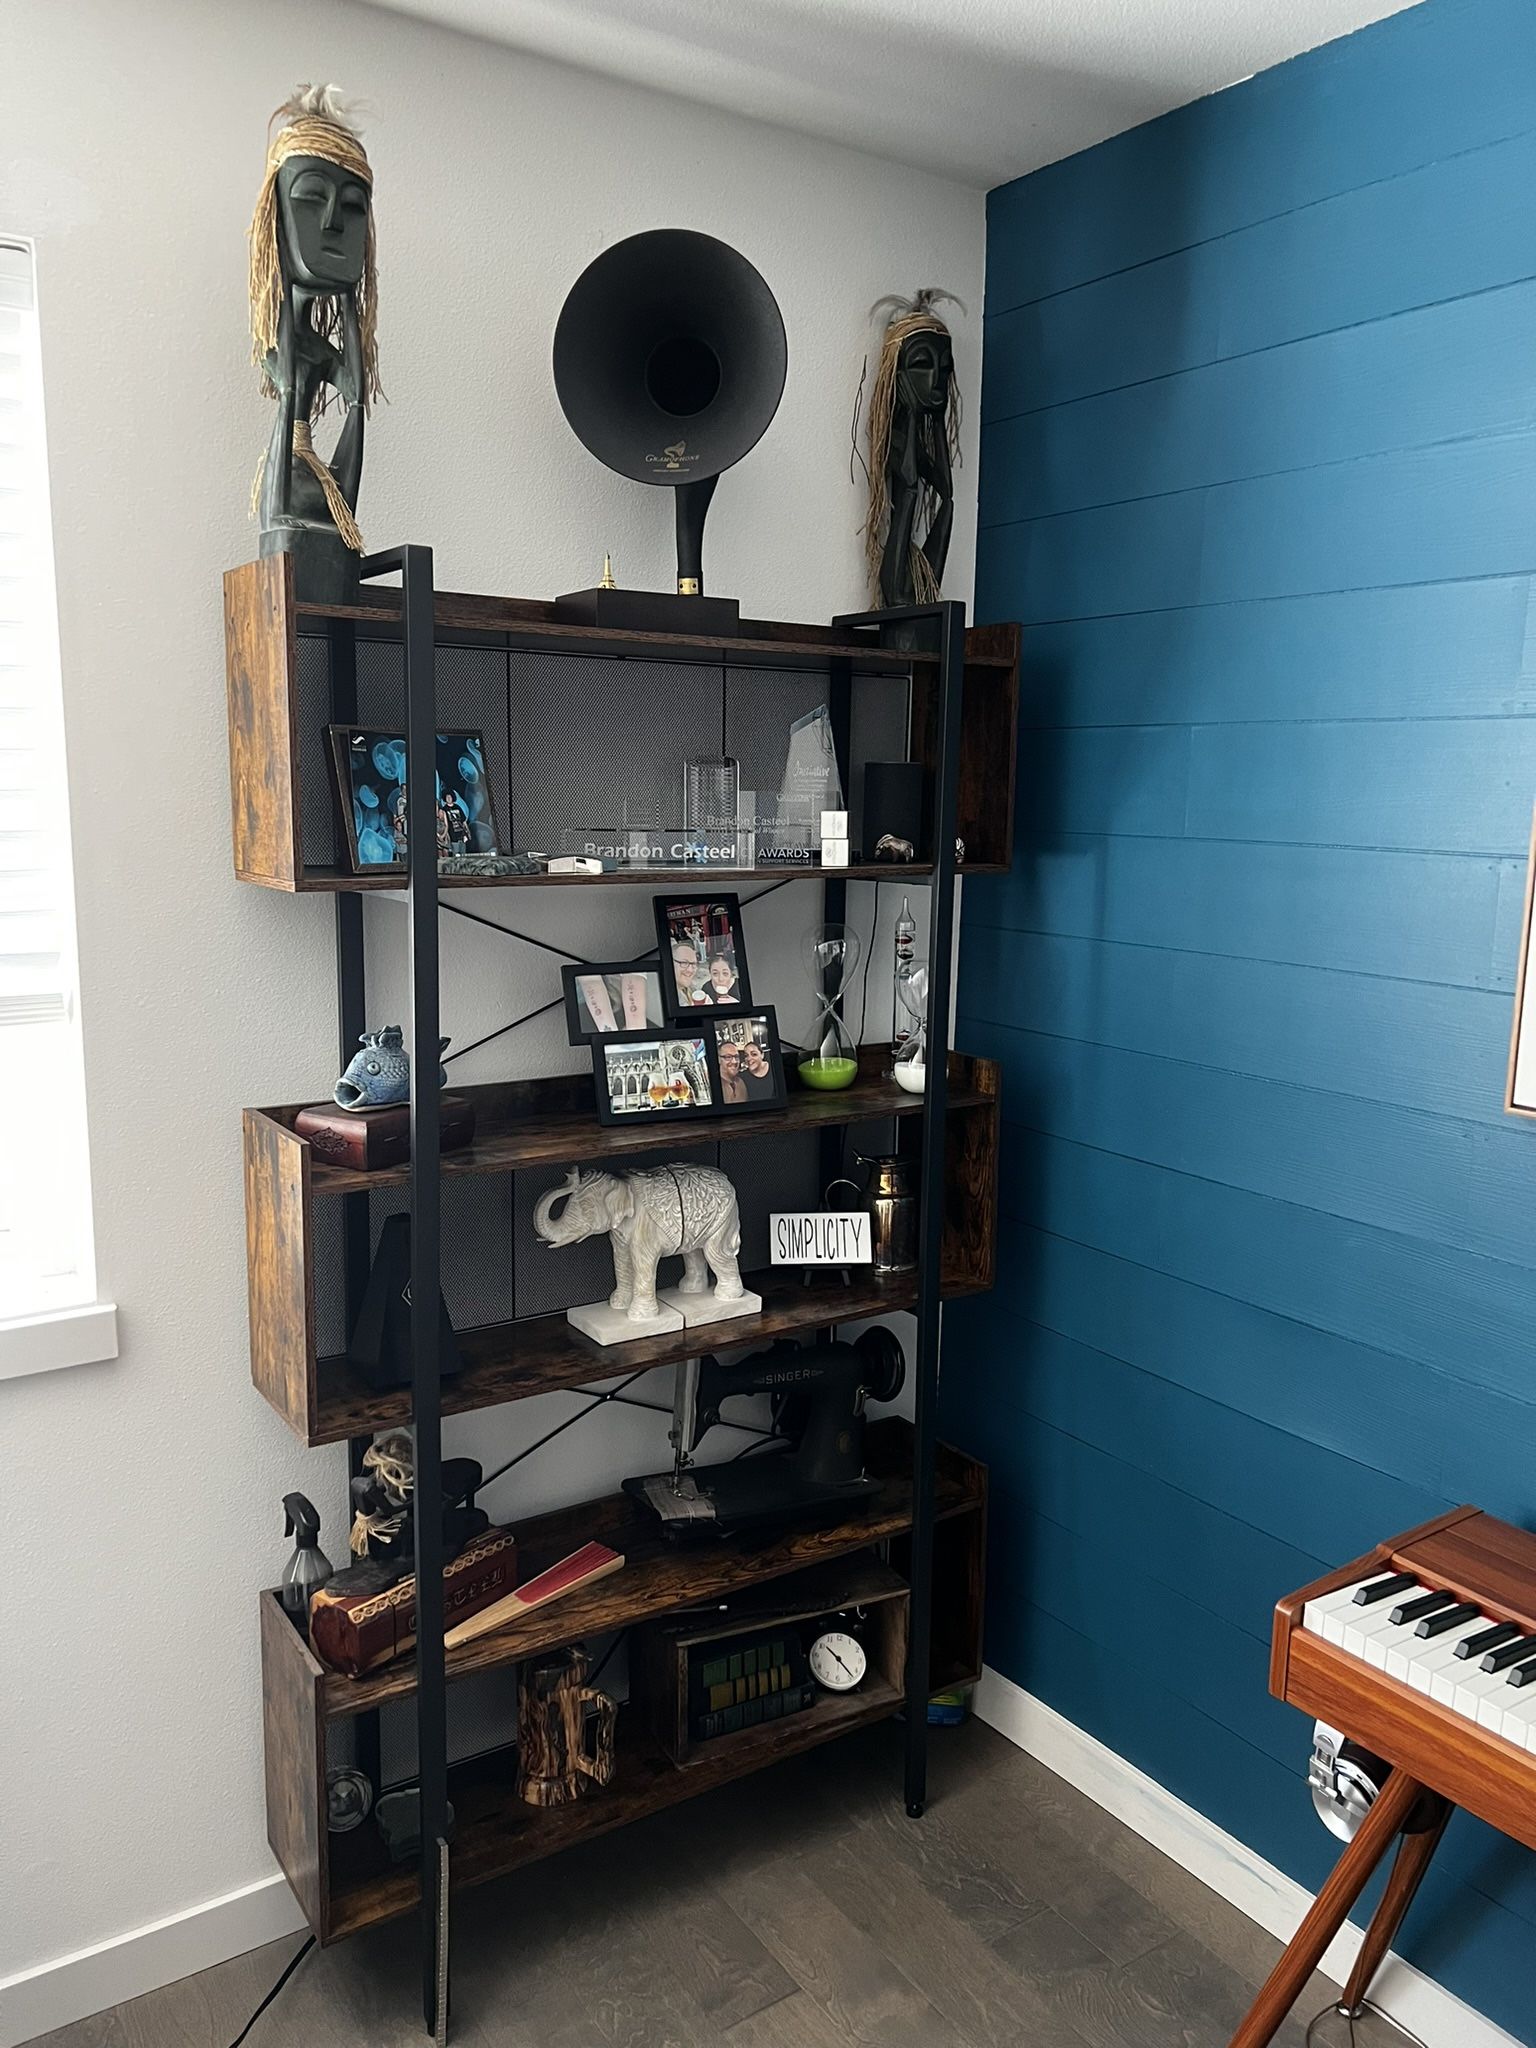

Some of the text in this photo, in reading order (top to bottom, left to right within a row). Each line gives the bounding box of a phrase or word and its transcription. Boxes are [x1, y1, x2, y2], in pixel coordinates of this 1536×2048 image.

[584, 843, 735, 859] Brandon Casteel
[758, 848, 810, 858] AWARDS
[777, 1218, 862, 1260] SIMPLICITY
[766, 1369, 811, 1385] SINGER
